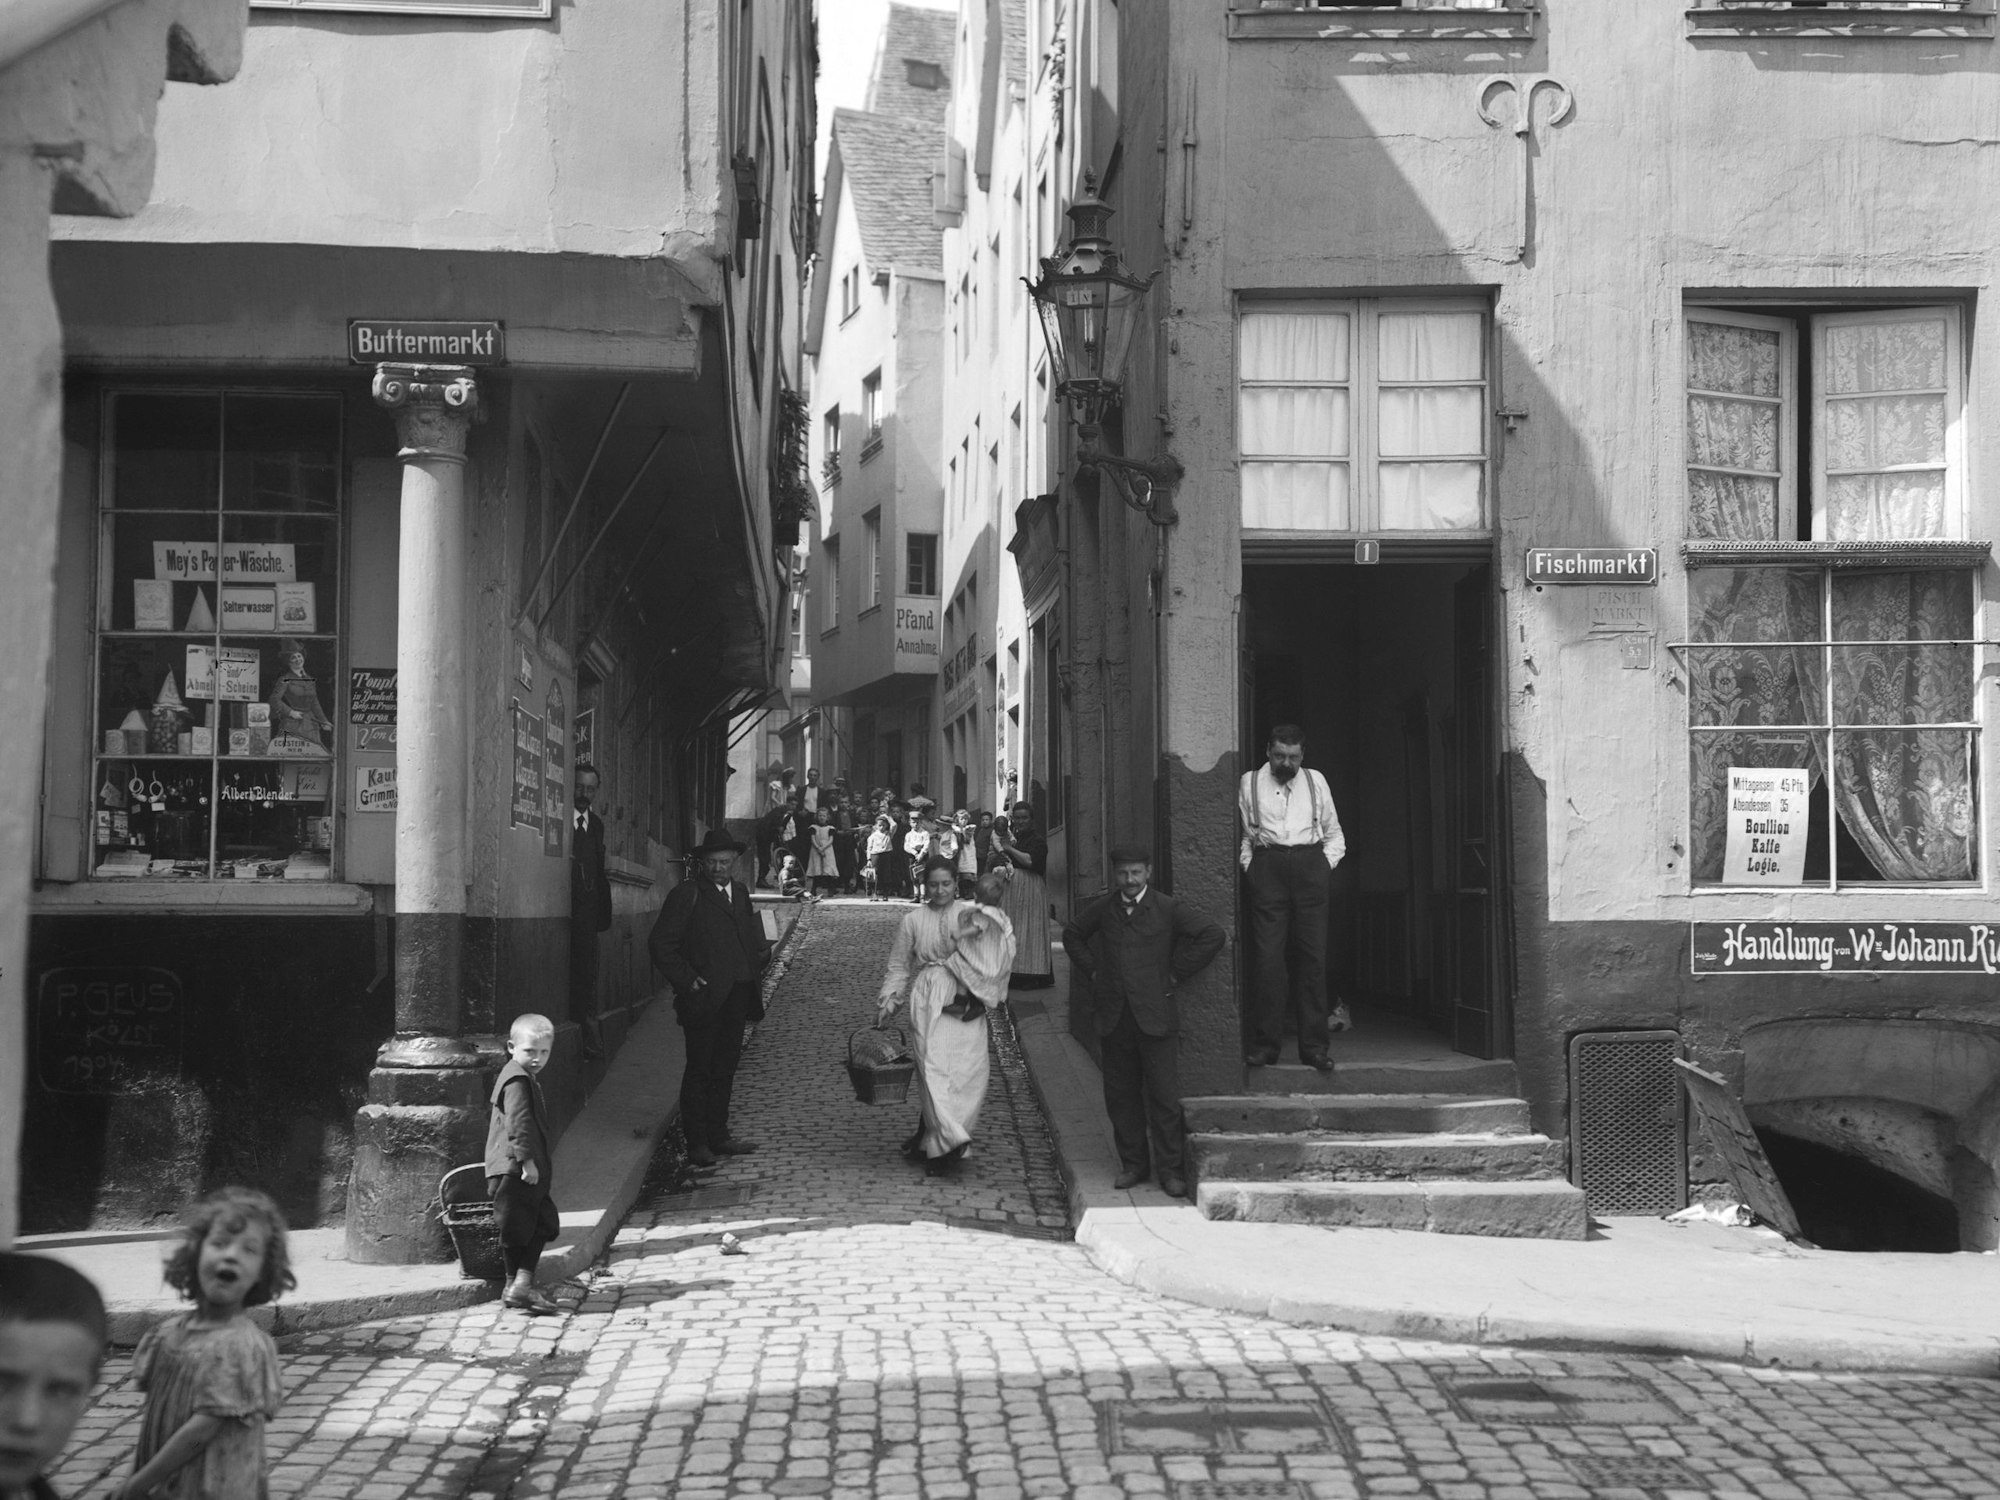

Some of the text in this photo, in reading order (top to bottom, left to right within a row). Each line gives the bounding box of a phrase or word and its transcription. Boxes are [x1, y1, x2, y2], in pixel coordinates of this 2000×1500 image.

[357, 327, 494, 355] Buttermarkt
[166, 549, 198, 577] Mey's
[1363, 543, 1370, 562] 1
[1535, 552, 1647, 575] Fischmarkt
[222, 599, 274, 614] Selterwasser
[895, 608, 934, 631] Pfand
[221, 785, 297, 802] Albert Blender.
[1733, 776, 1775, 794] Mittagessen
[1779, 778, 1790, 792] 45
[1733, 797, 1789, 813] Abendessen 35
[1722, 923, 1835, 970] Handlung
[1834, 945, 1851, 956] von
[1882, 924, 1967, 962] Johann
[1967, 924, 2000, 975] Ri
[83, 981, 174, 1016] GEUS
